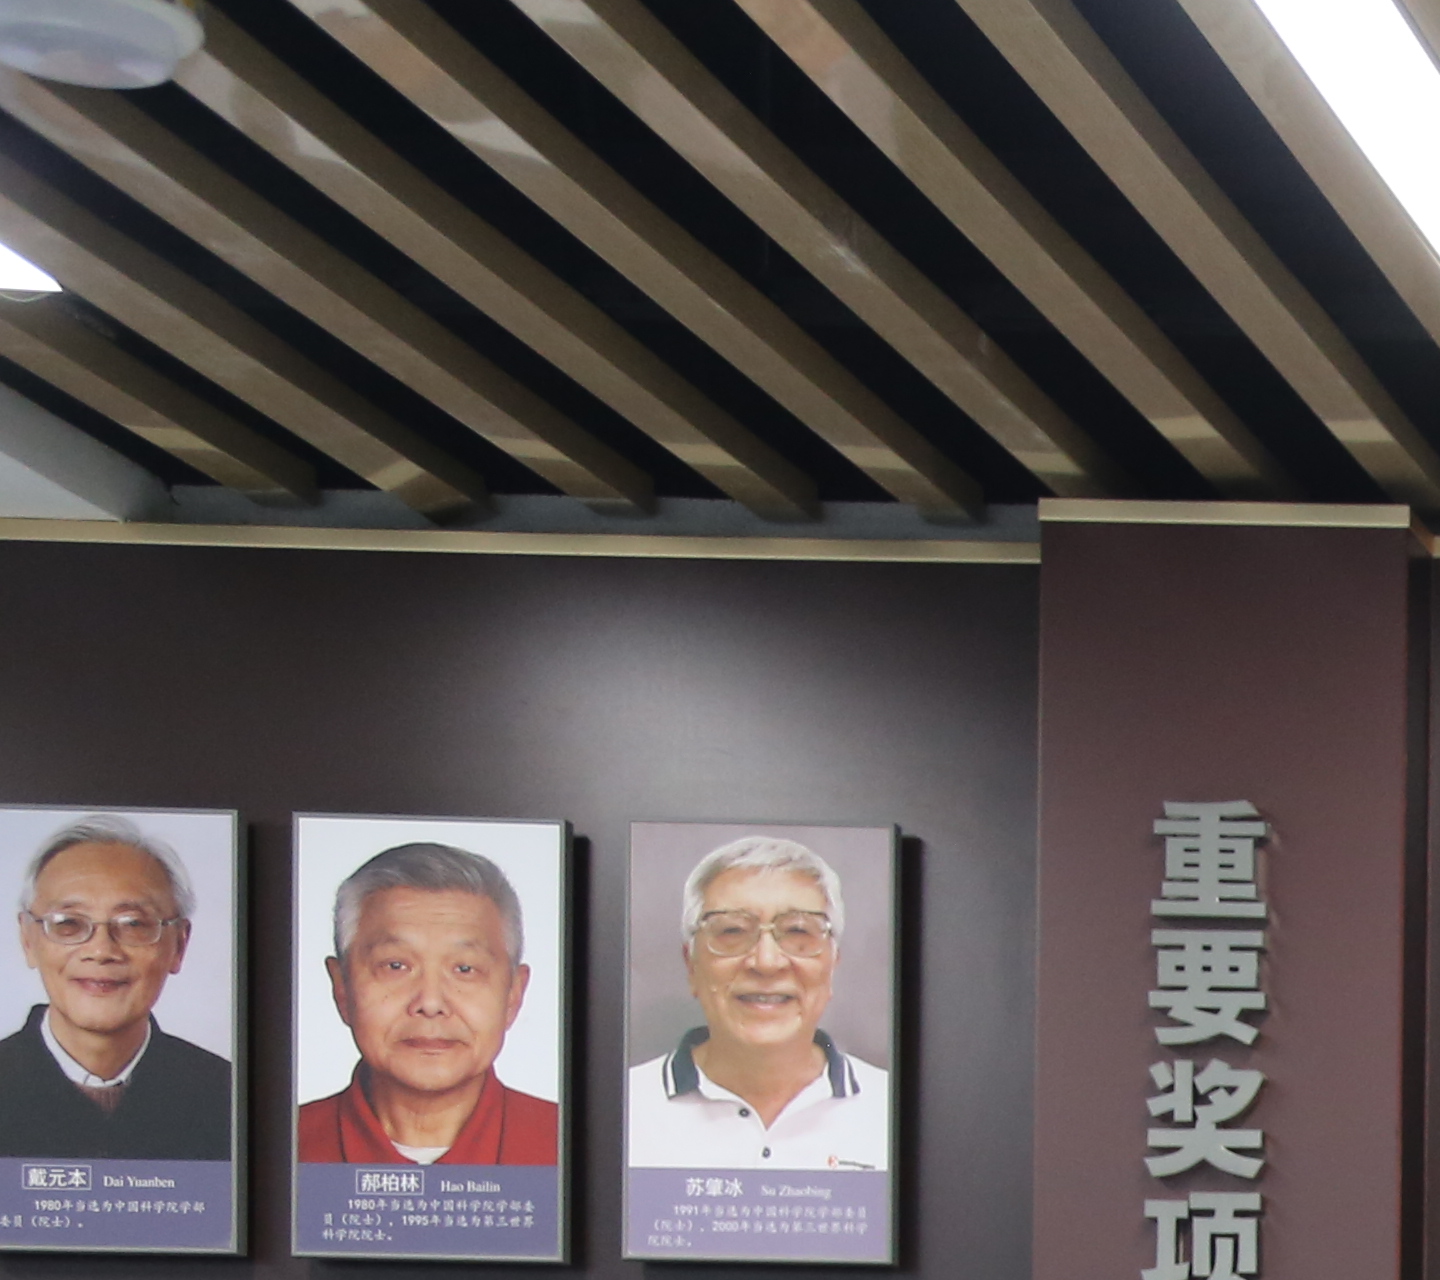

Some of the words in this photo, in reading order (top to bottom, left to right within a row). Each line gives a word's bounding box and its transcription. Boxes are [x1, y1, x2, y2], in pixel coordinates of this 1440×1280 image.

[28, 1168, 87, 1187] 戴元本
[103, 1176, 124, 1187] Dai
[127, 1176, 175, 1188] Yuanben
[361, 1173, 420, 1193] 郝柏林
[441, 1180, 464, 1192] Hao
[467, 1181, 501, 1193] Bailin
[685, 1177, 744, 1197] 苏肇冰
[761, 1185, 776, 1196] Su
[779, 1186, 832, 1200] Zhaobing
